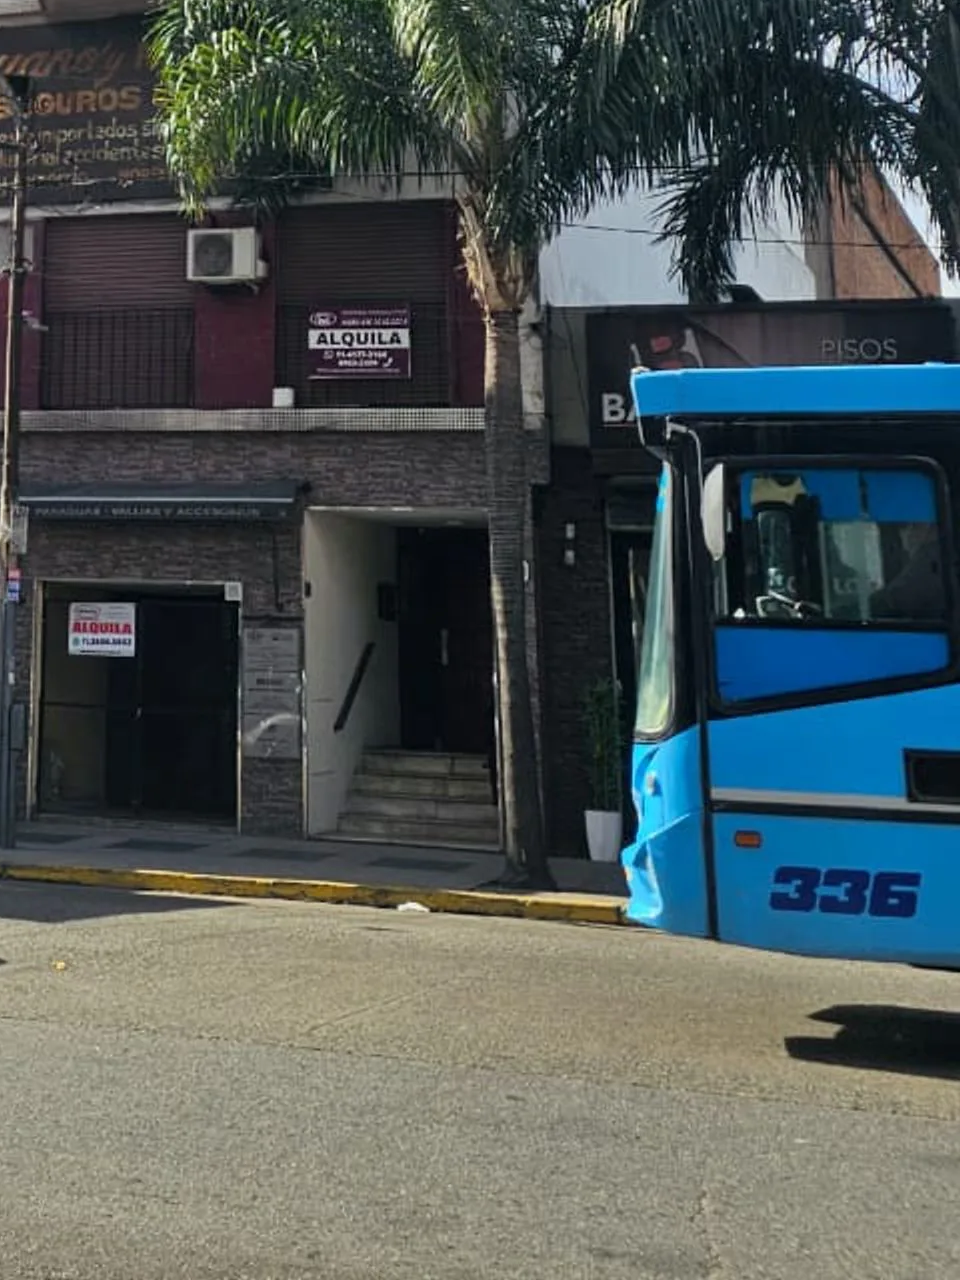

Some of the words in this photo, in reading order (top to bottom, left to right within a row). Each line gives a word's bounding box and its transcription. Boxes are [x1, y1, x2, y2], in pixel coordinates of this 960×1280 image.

[316, 331, 402, 347] ALQUILA
[821, 338, 898, 361] PISOS
[73, 622, 132, 635] ALQUILA
[769, 866, 921, 918] 336
